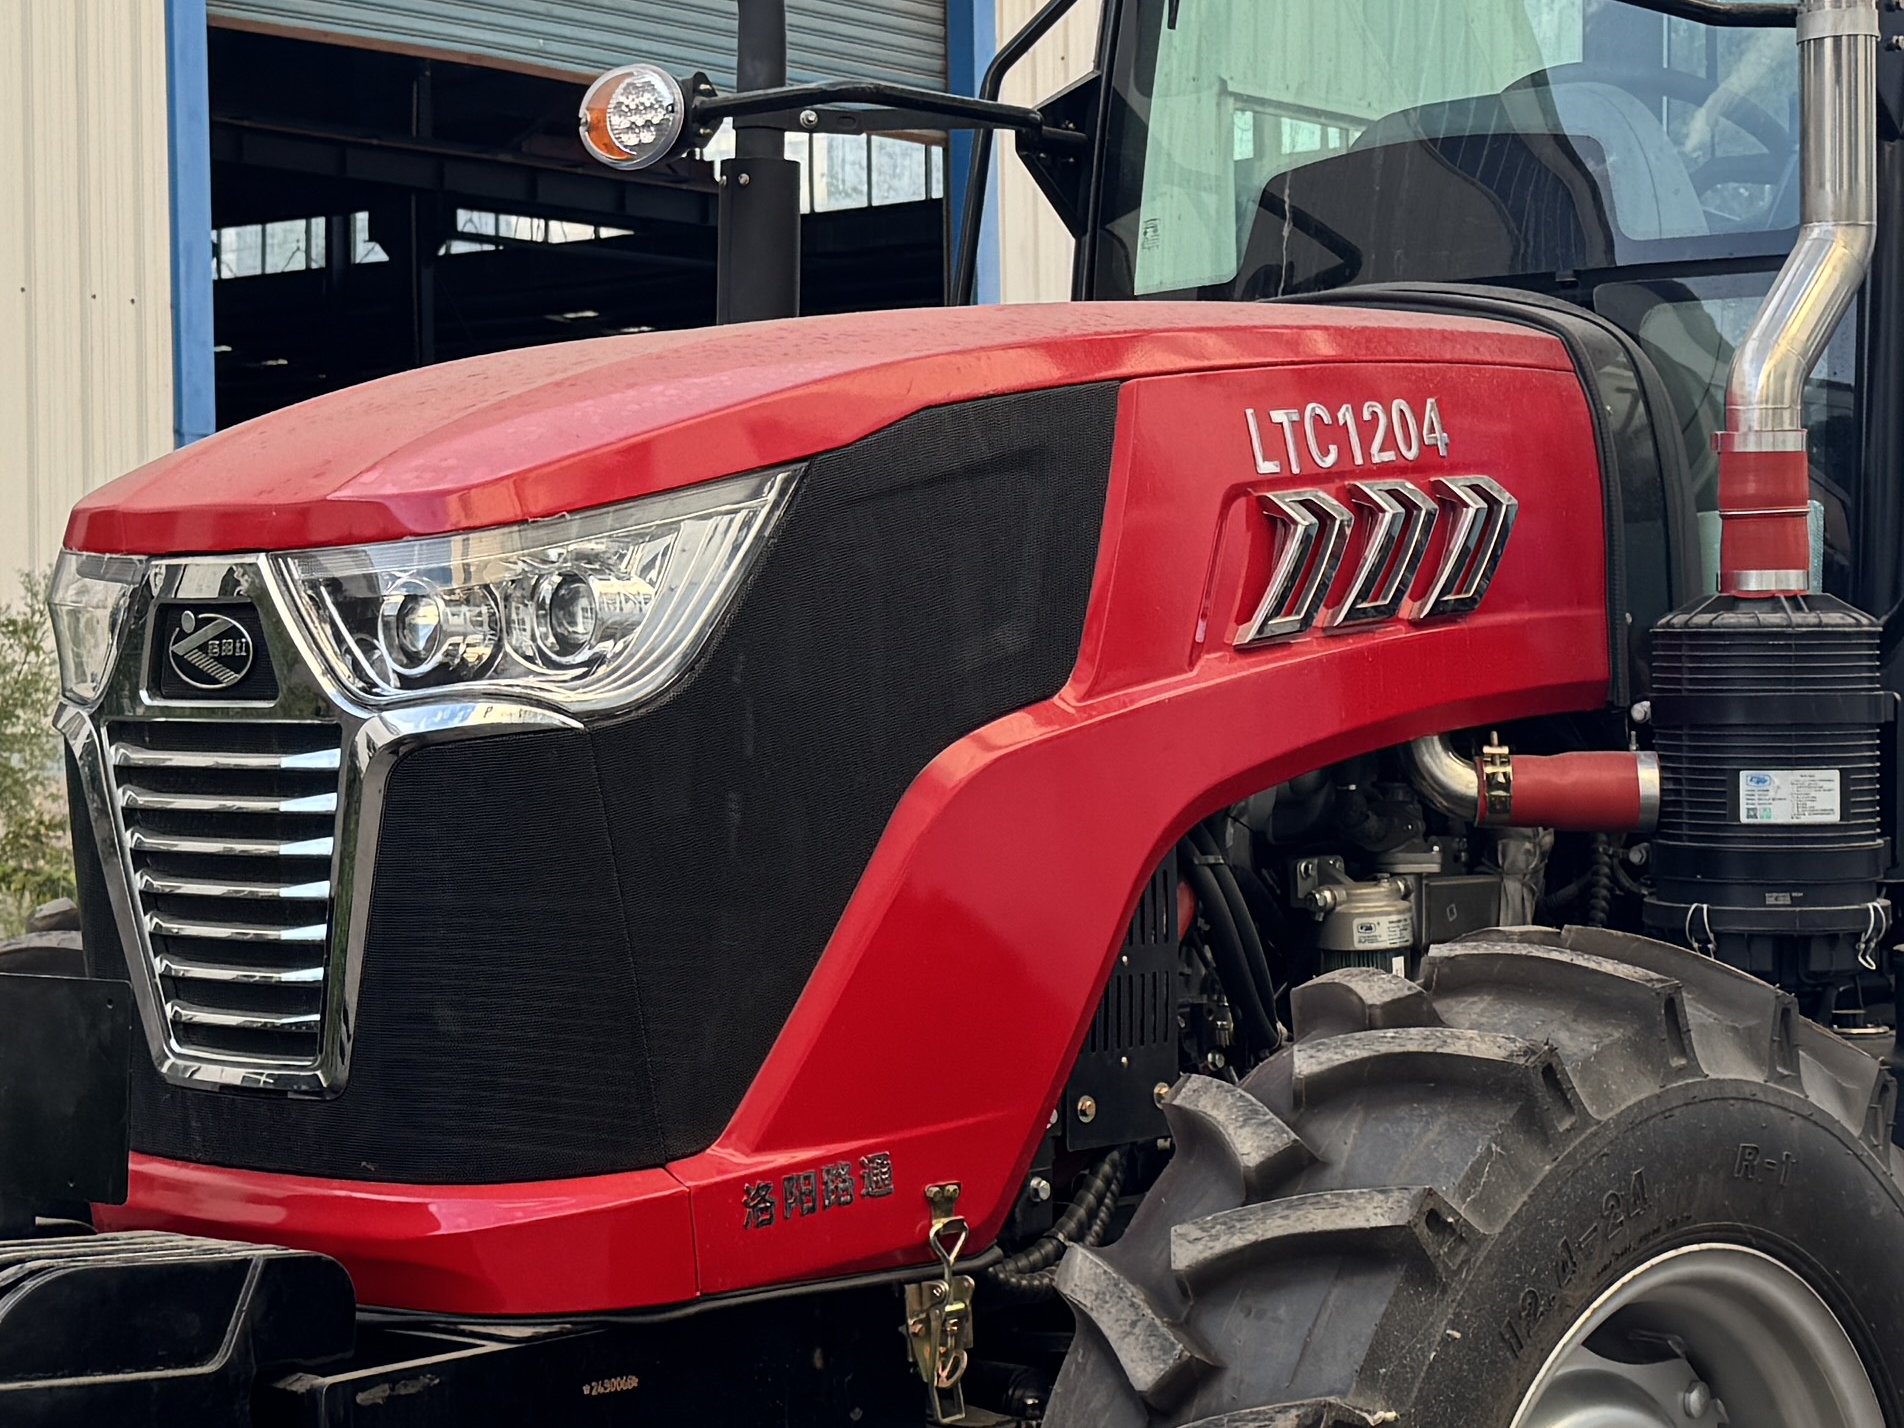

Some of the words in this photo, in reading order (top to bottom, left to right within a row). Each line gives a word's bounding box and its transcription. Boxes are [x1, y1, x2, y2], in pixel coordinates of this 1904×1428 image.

[1246, 398, 1449, 474] LTC1204
[742, 1152, 894, 1228] 洛阳路通
